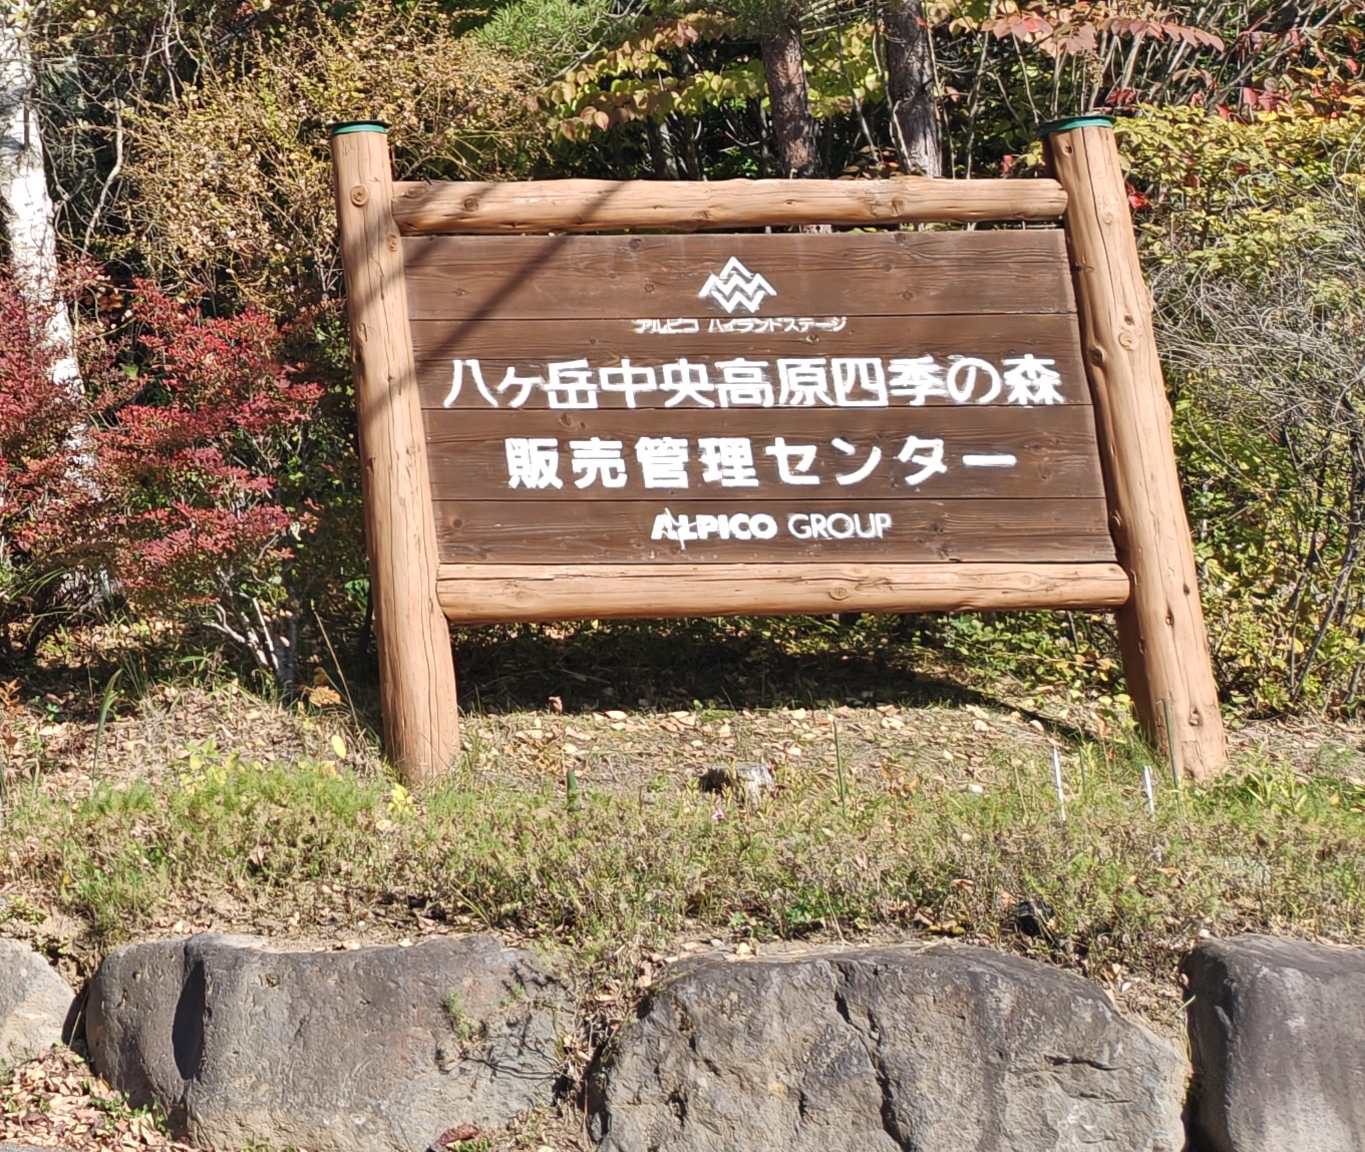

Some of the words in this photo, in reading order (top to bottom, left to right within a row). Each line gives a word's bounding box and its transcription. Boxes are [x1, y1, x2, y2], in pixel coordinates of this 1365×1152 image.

[708, 316, 848, 334] ハイランドステージ
[505, 436, 1019, 490] 販売管理センター
[651, 508, 778, 544] ALPICO
[787, 512, 893, 540] GROUP
